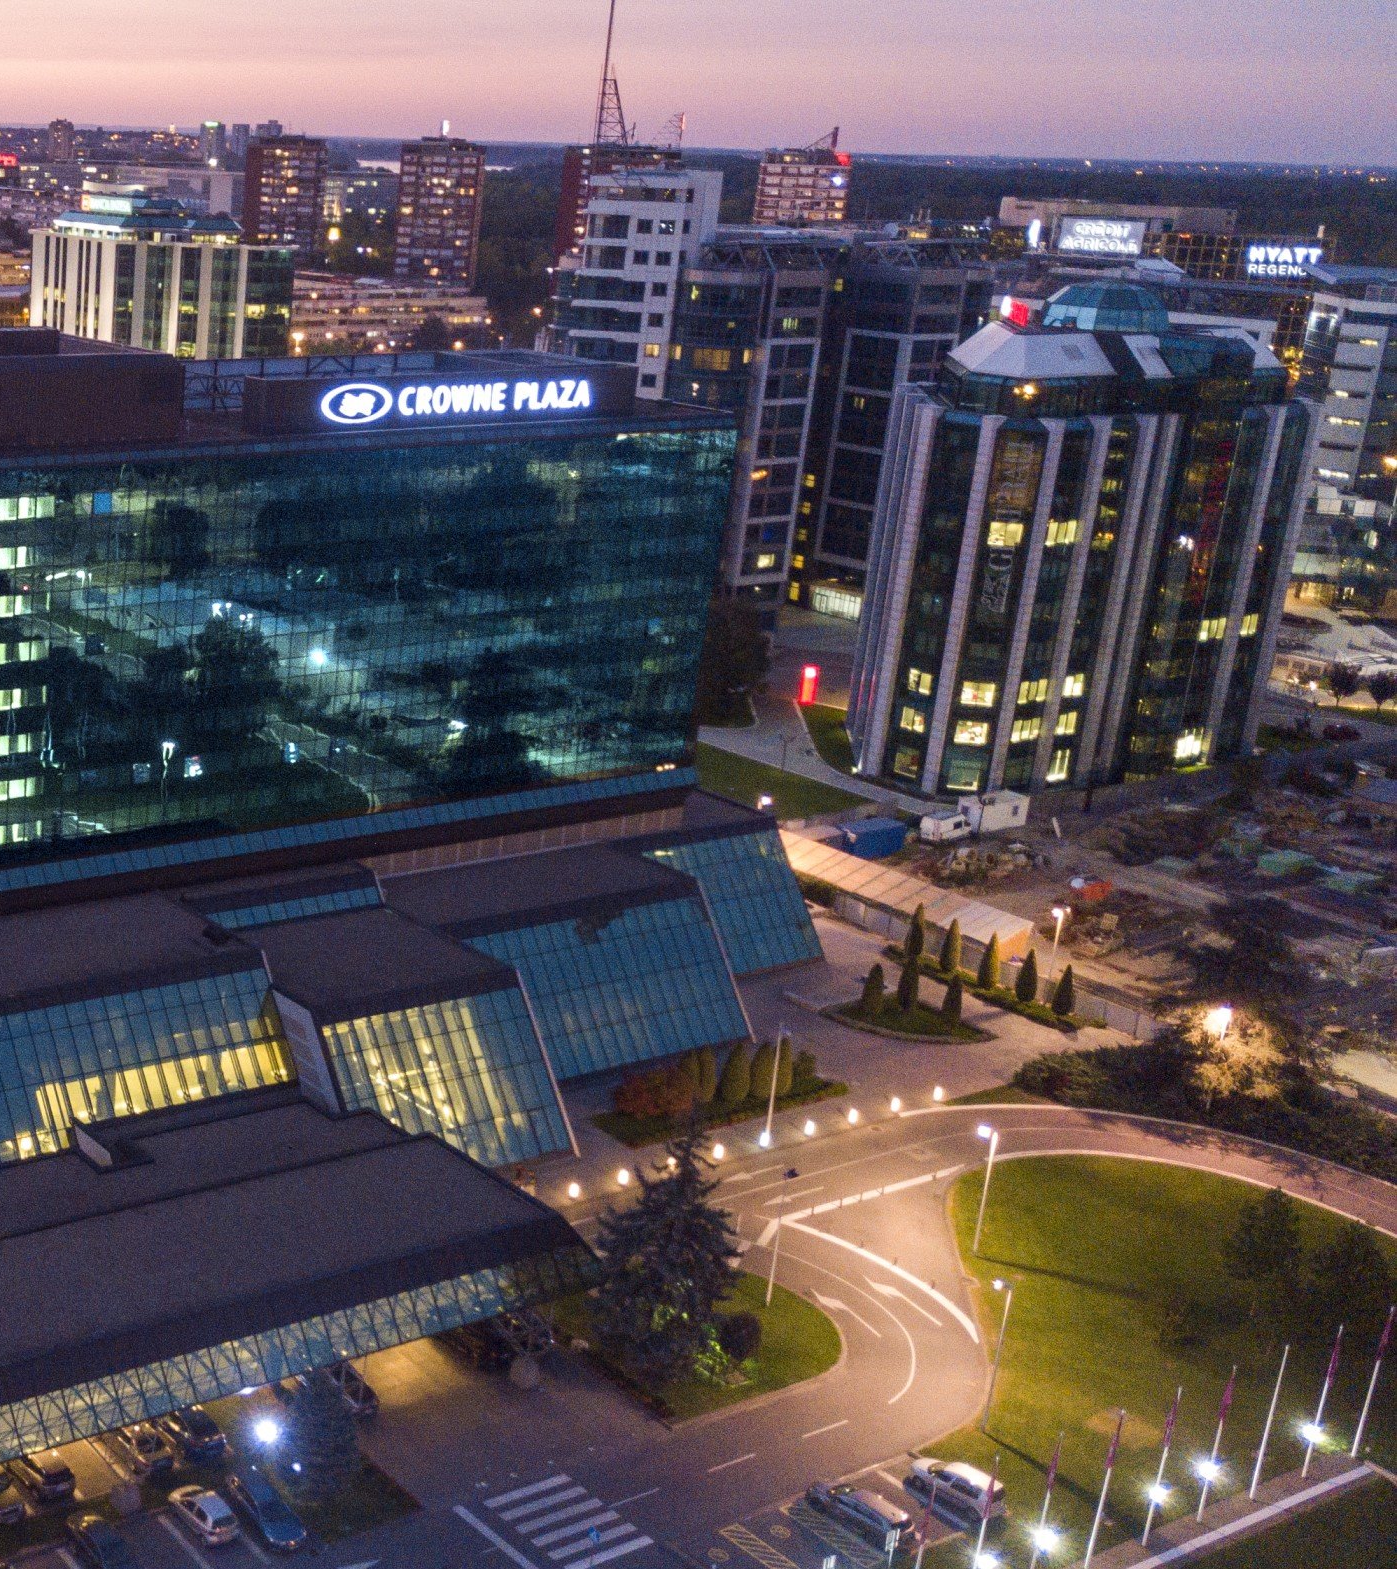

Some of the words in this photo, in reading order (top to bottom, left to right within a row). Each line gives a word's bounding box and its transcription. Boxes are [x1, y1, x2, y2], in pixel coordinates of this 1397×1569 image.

[1059, 236, 1139, 253] AGRICOLE
[1249, 246, 1322, 264] HYATT
[1248, 263, 1307, 276] REGENC
[398, 382, 508, 416] CROWNE
[513, 379, 590, 411] PLAZA
